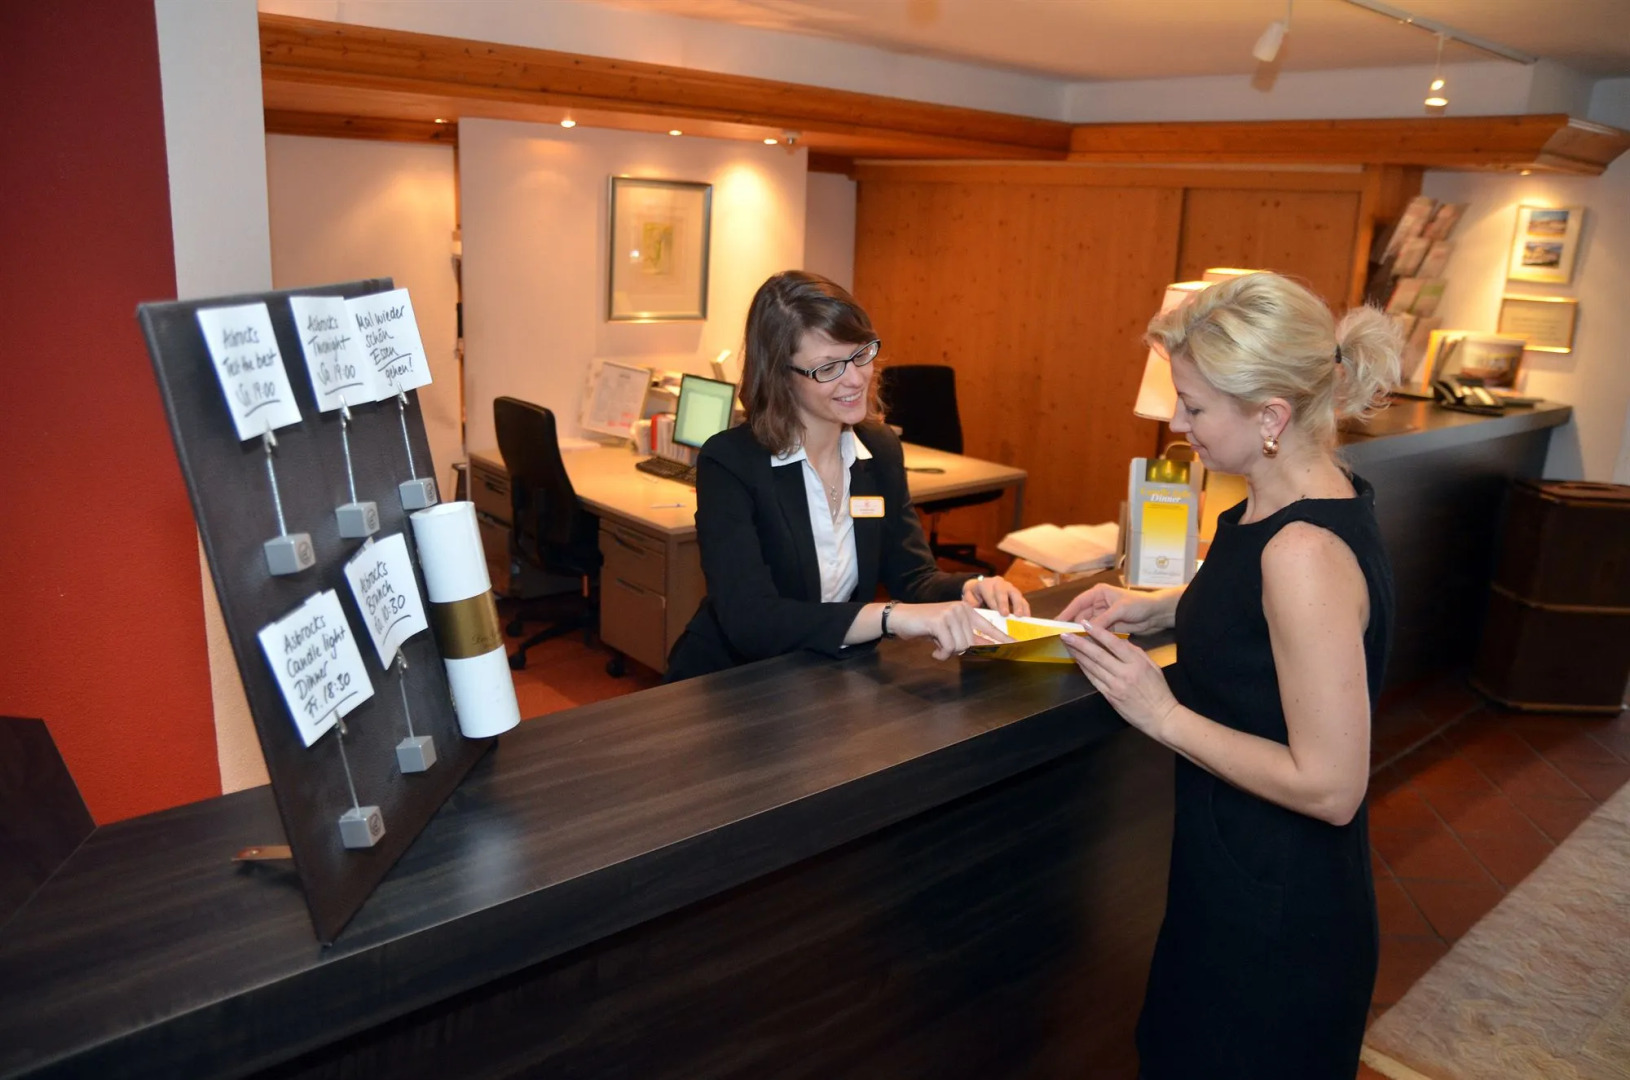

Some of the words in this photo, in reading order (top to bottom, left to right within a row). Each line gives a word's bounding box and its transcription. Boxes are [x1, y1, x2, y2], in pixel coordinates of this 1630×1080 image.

[355, 311, 374, 332] Mal
[375, 305, 405, 325] wieder
[369, 346, 399, 366] Essen
[385, 356, 413, 387] gehen!
[1150, 493, 1182, 503] Dinner
[322, 625, 346, 660] light
[294, 660, 329, 701] Dinner
[323, 672, 351, 704] 18:30
